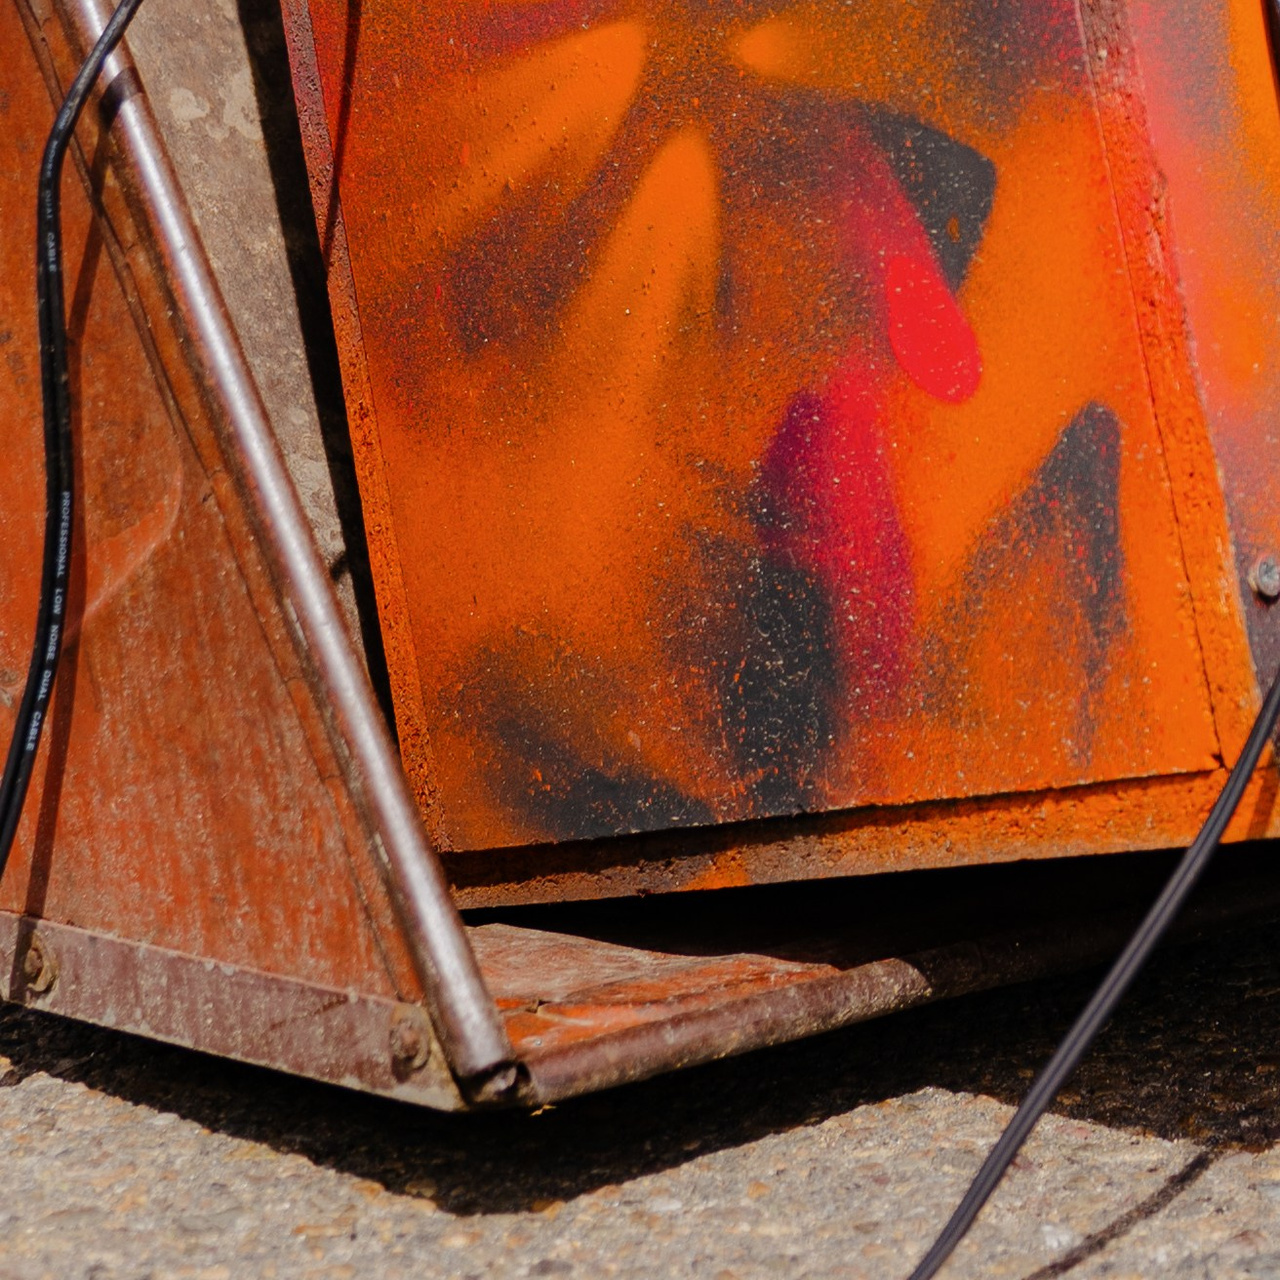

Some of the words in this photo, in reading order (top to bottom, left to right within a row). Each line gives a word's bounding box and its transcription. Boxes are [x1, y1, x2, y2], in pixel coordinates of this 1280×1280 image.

[46, 231, 58, 273] CABLE
[56, 490, 71, 577] PROFESSIONAL
[52, 587, 64, 615] LOW
[45, 623, 59, 661] NOISE
[37, 669, 52, 701] DUAL
[25, 711, 42, 751] CABLE
